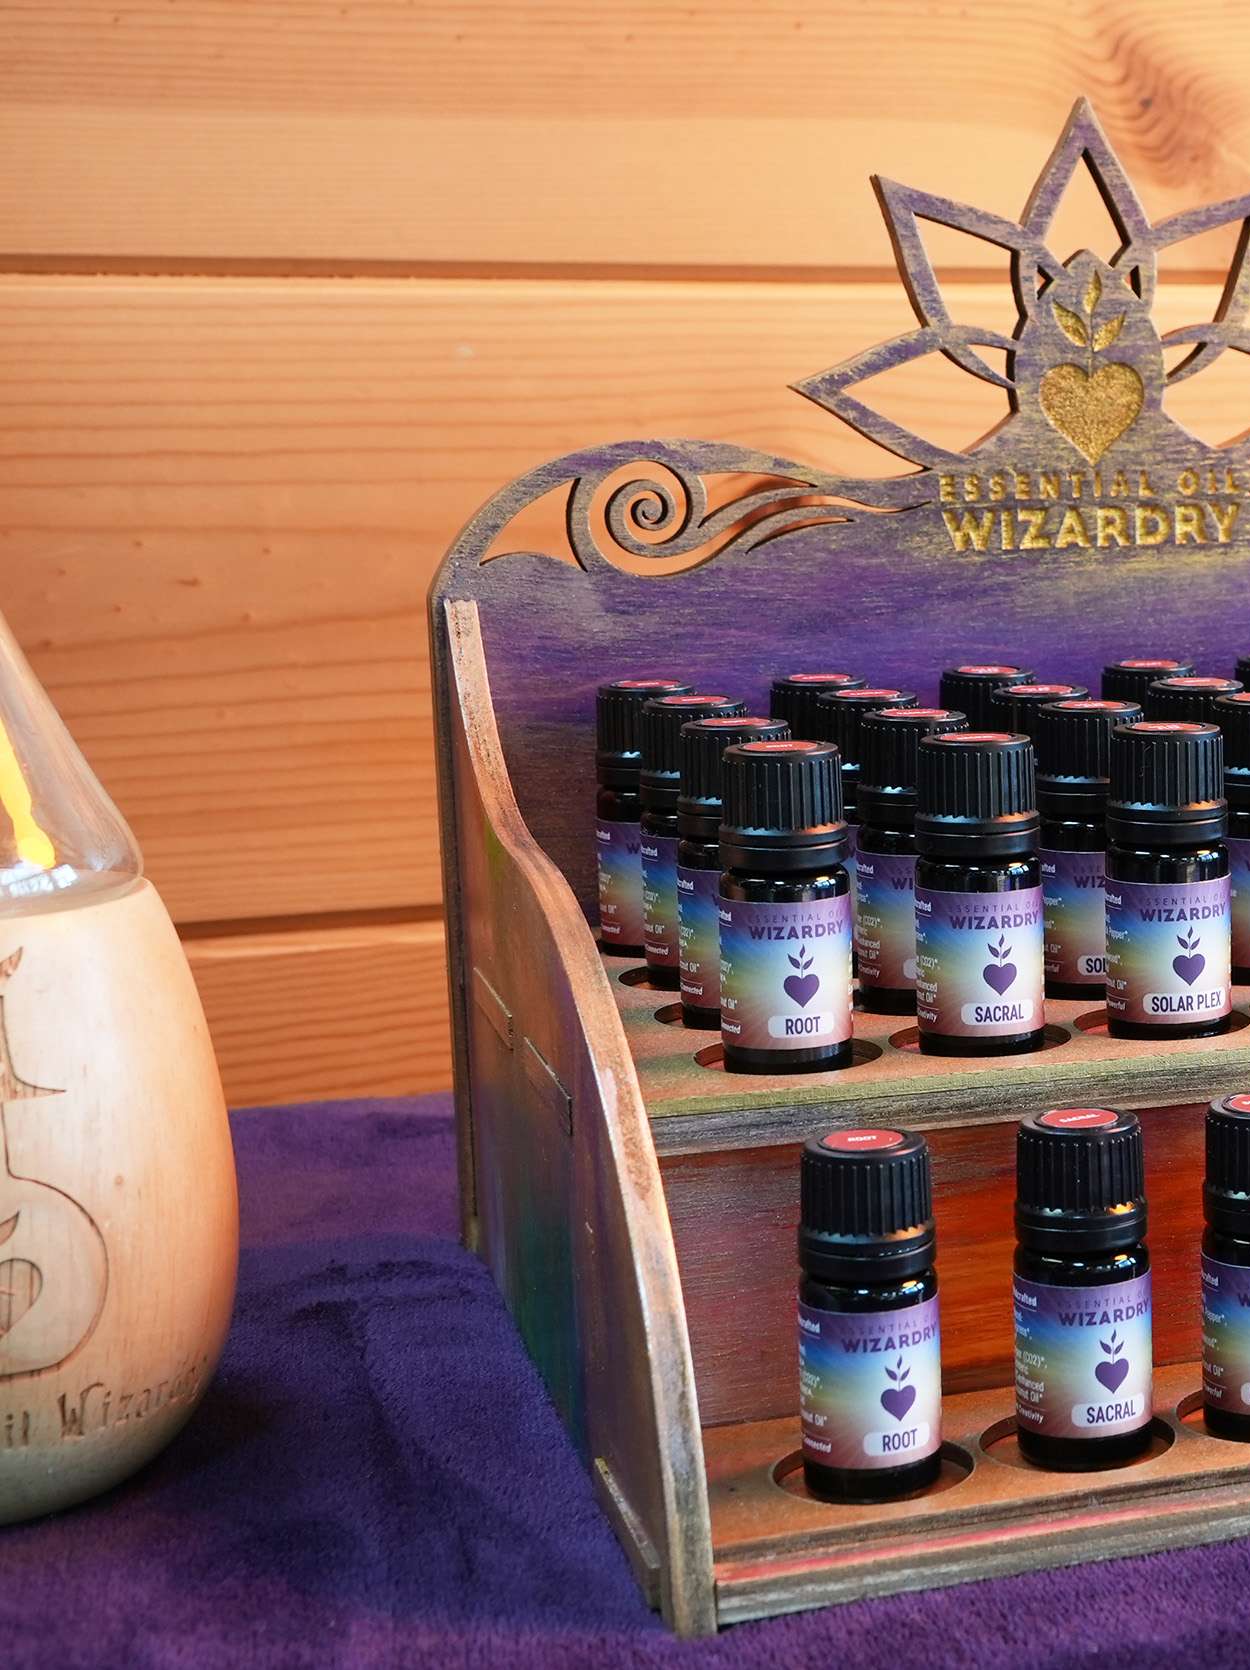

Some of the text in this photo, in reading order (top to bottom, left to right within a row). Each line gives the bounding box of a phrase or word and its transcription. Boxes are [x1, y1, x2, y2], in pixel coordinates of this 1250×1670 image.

[939, 466, 1240, 502] ESSENTIAL OIL
[941, 502, 1241, 551] WIZARDRY
[949, 910, 1040, 930] WIZARDRY
[1140, 903, 1226, 922] WIZARDRY
[749, 919, 845, 940] WIZARDRY
[974, 1003, 1024, 1023] SACRAL
[1151, 990, 1221, 1013] SOLAR PLEX
[785, 1016, 820, 1035] ROOT
[1058, 1299, 1149, 1326] WIZARDRY
[841, 1323, 937, 1353] WIZARDRY
[1086, 1400, 1136, 1424] SACRAL
[5, 1411, 30, 1447] il
[882, 1428, 918, 1452] ROOT
